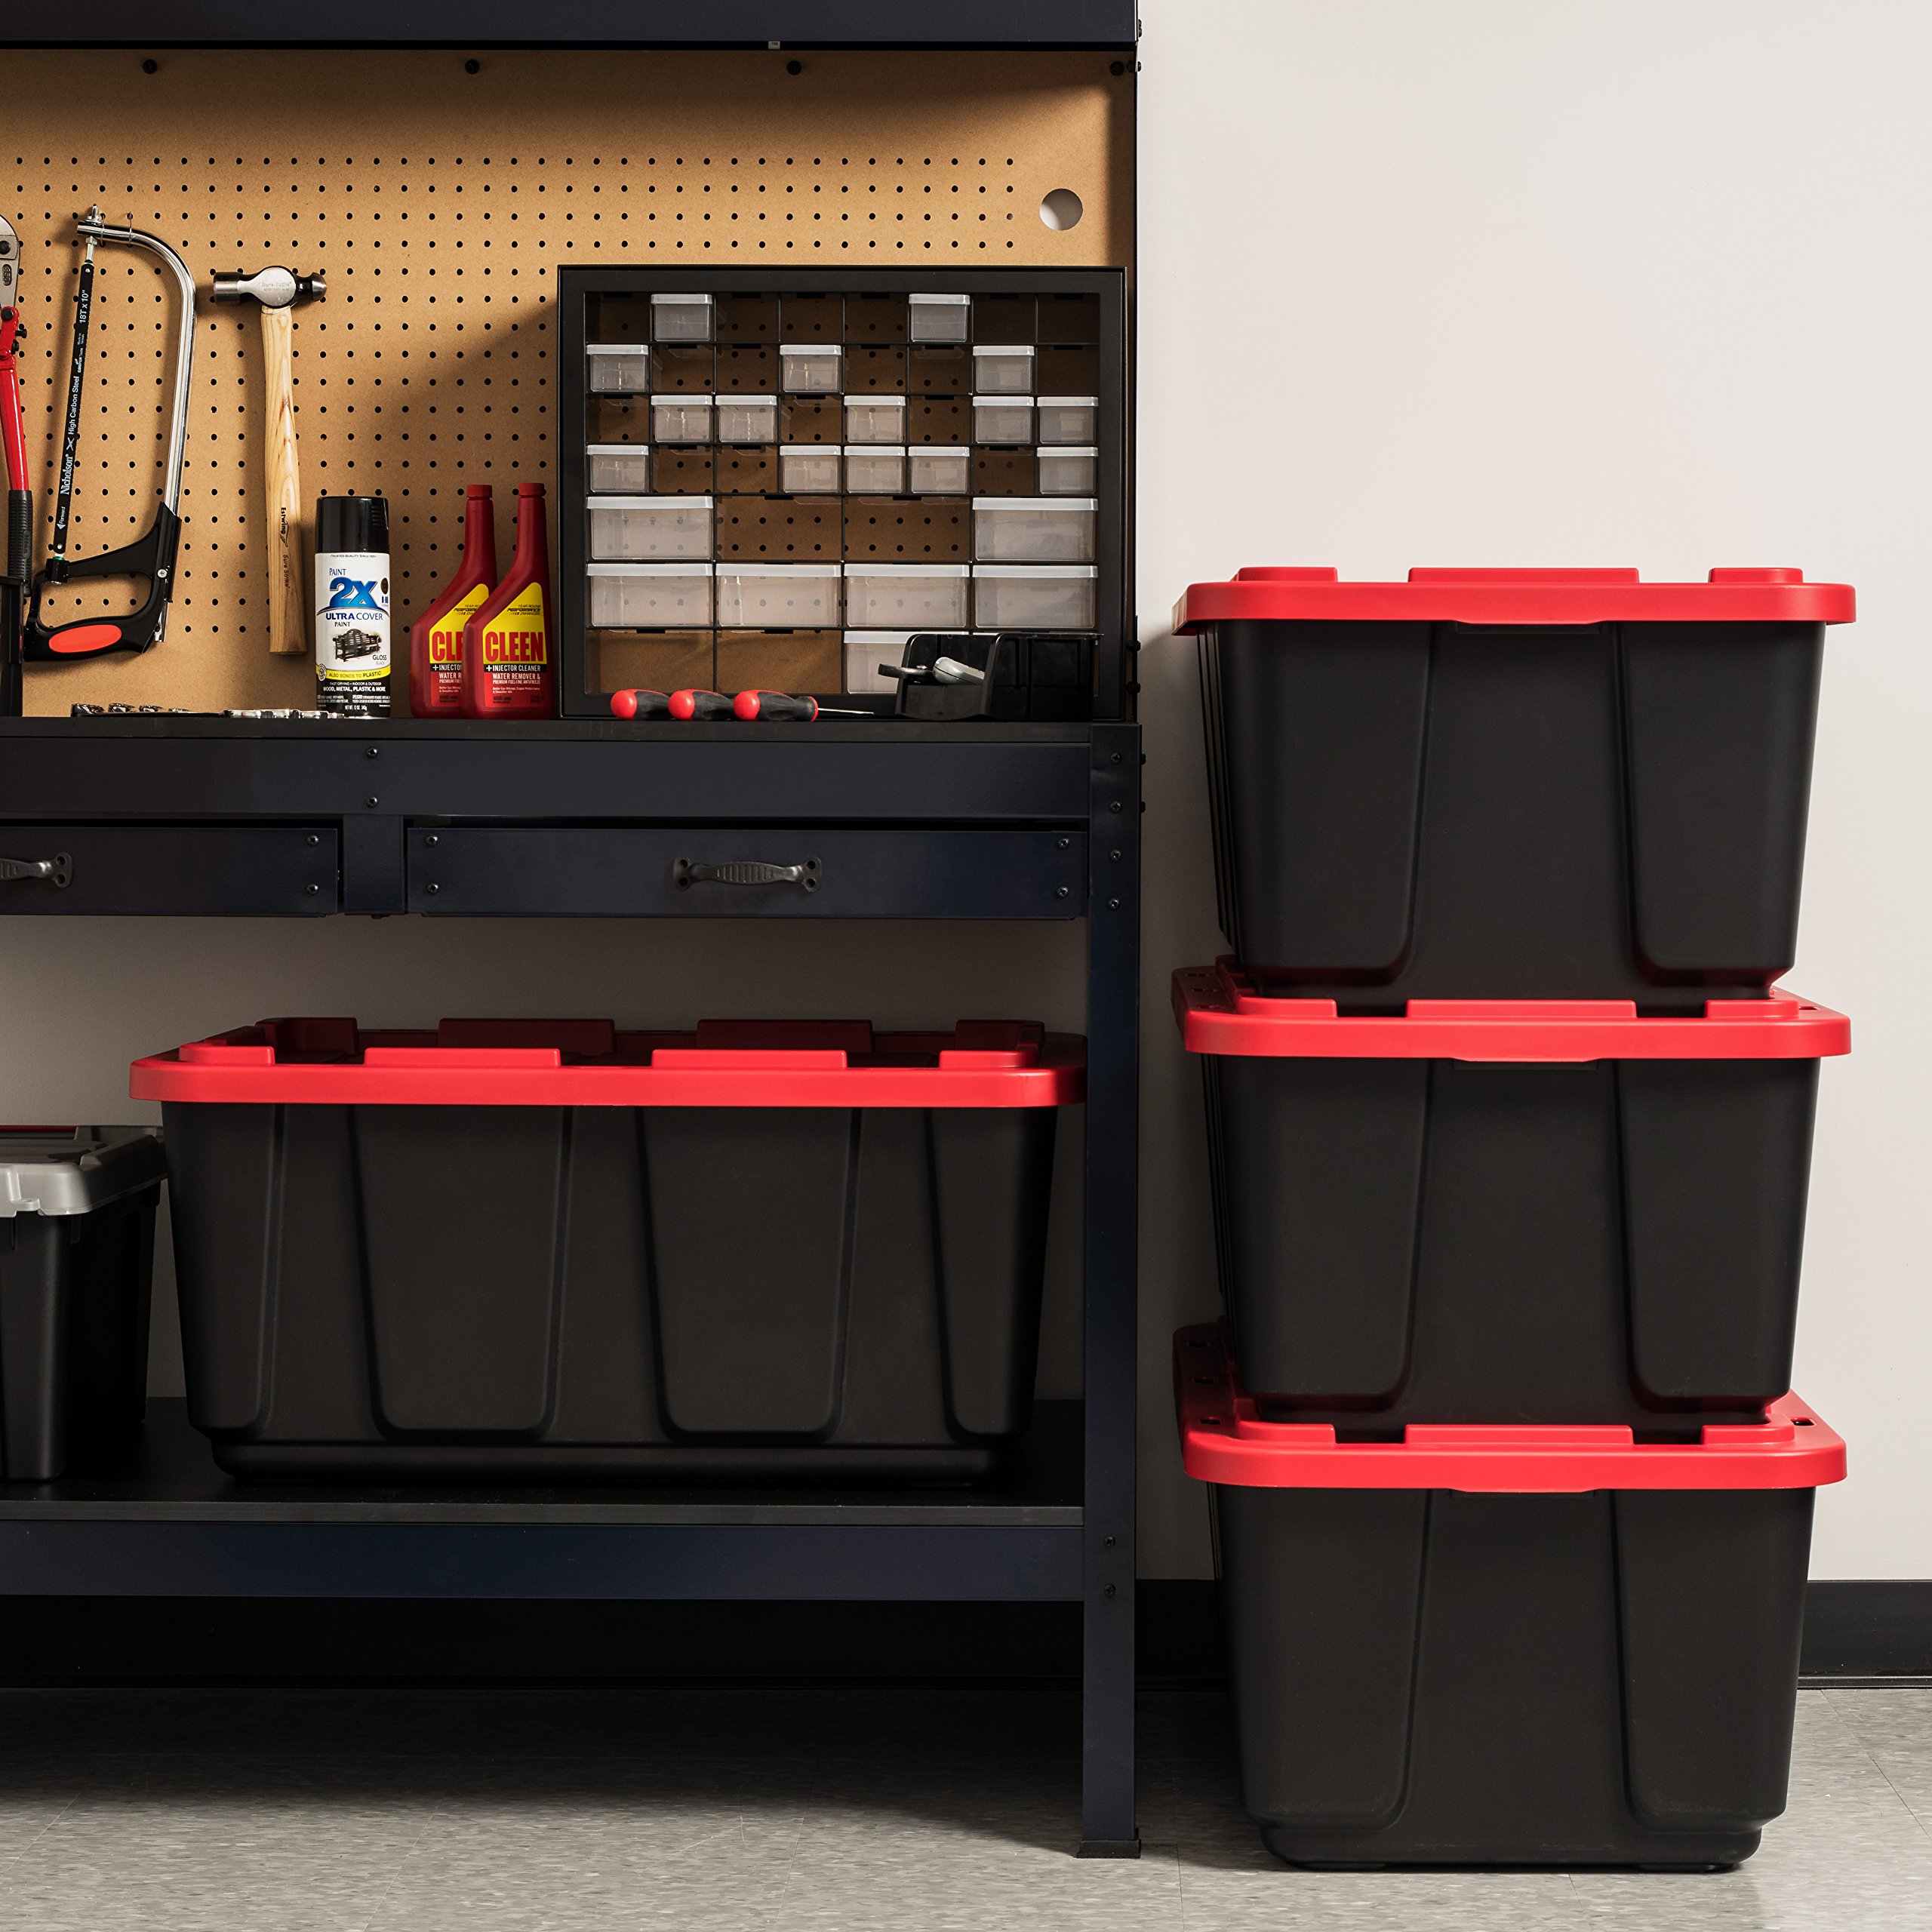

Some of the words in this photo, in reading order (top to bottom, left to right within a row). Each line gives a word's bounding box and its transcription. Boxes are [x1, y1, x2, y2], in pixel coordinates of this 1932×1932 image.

[69, 394, 78, 418] Carbon
[68, 419, 76, 435] High
[329, 577, 378, 608] 2X
[432, 631, 463, 661] CLE
[485, 631, 544, 662] CLEEN
